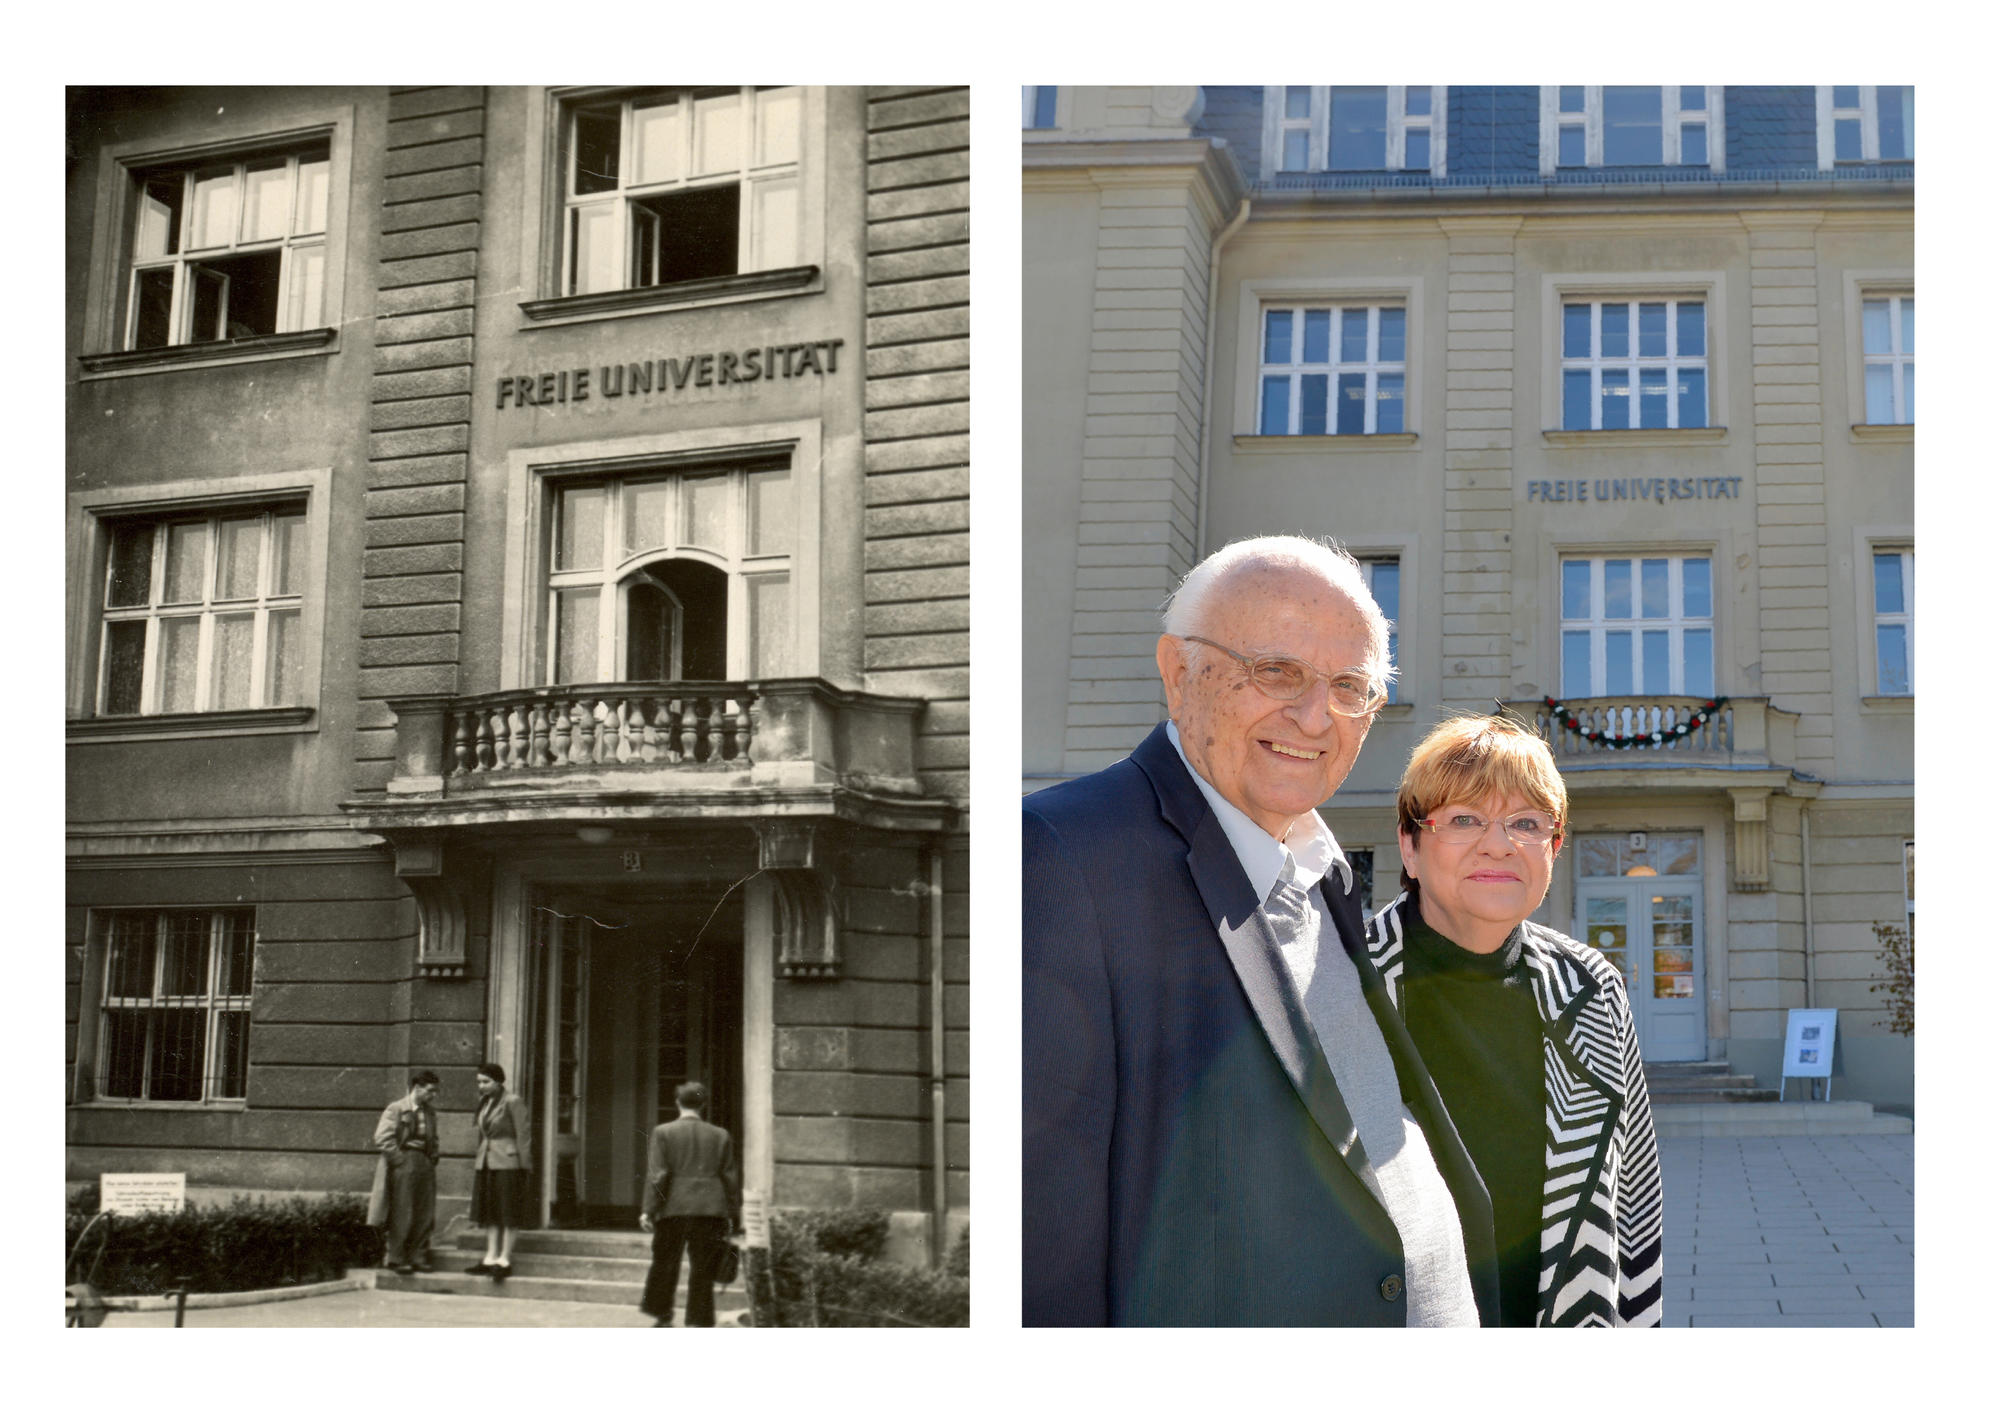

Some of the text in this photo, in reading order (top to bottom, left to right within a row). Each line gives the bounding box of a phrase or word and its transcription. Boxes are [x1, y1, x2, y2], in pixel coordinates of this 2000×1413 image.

[495, 338, 844, 409] FREIE UNIVERSITÄT
[1527, 479, 1589, 502] FREIE
